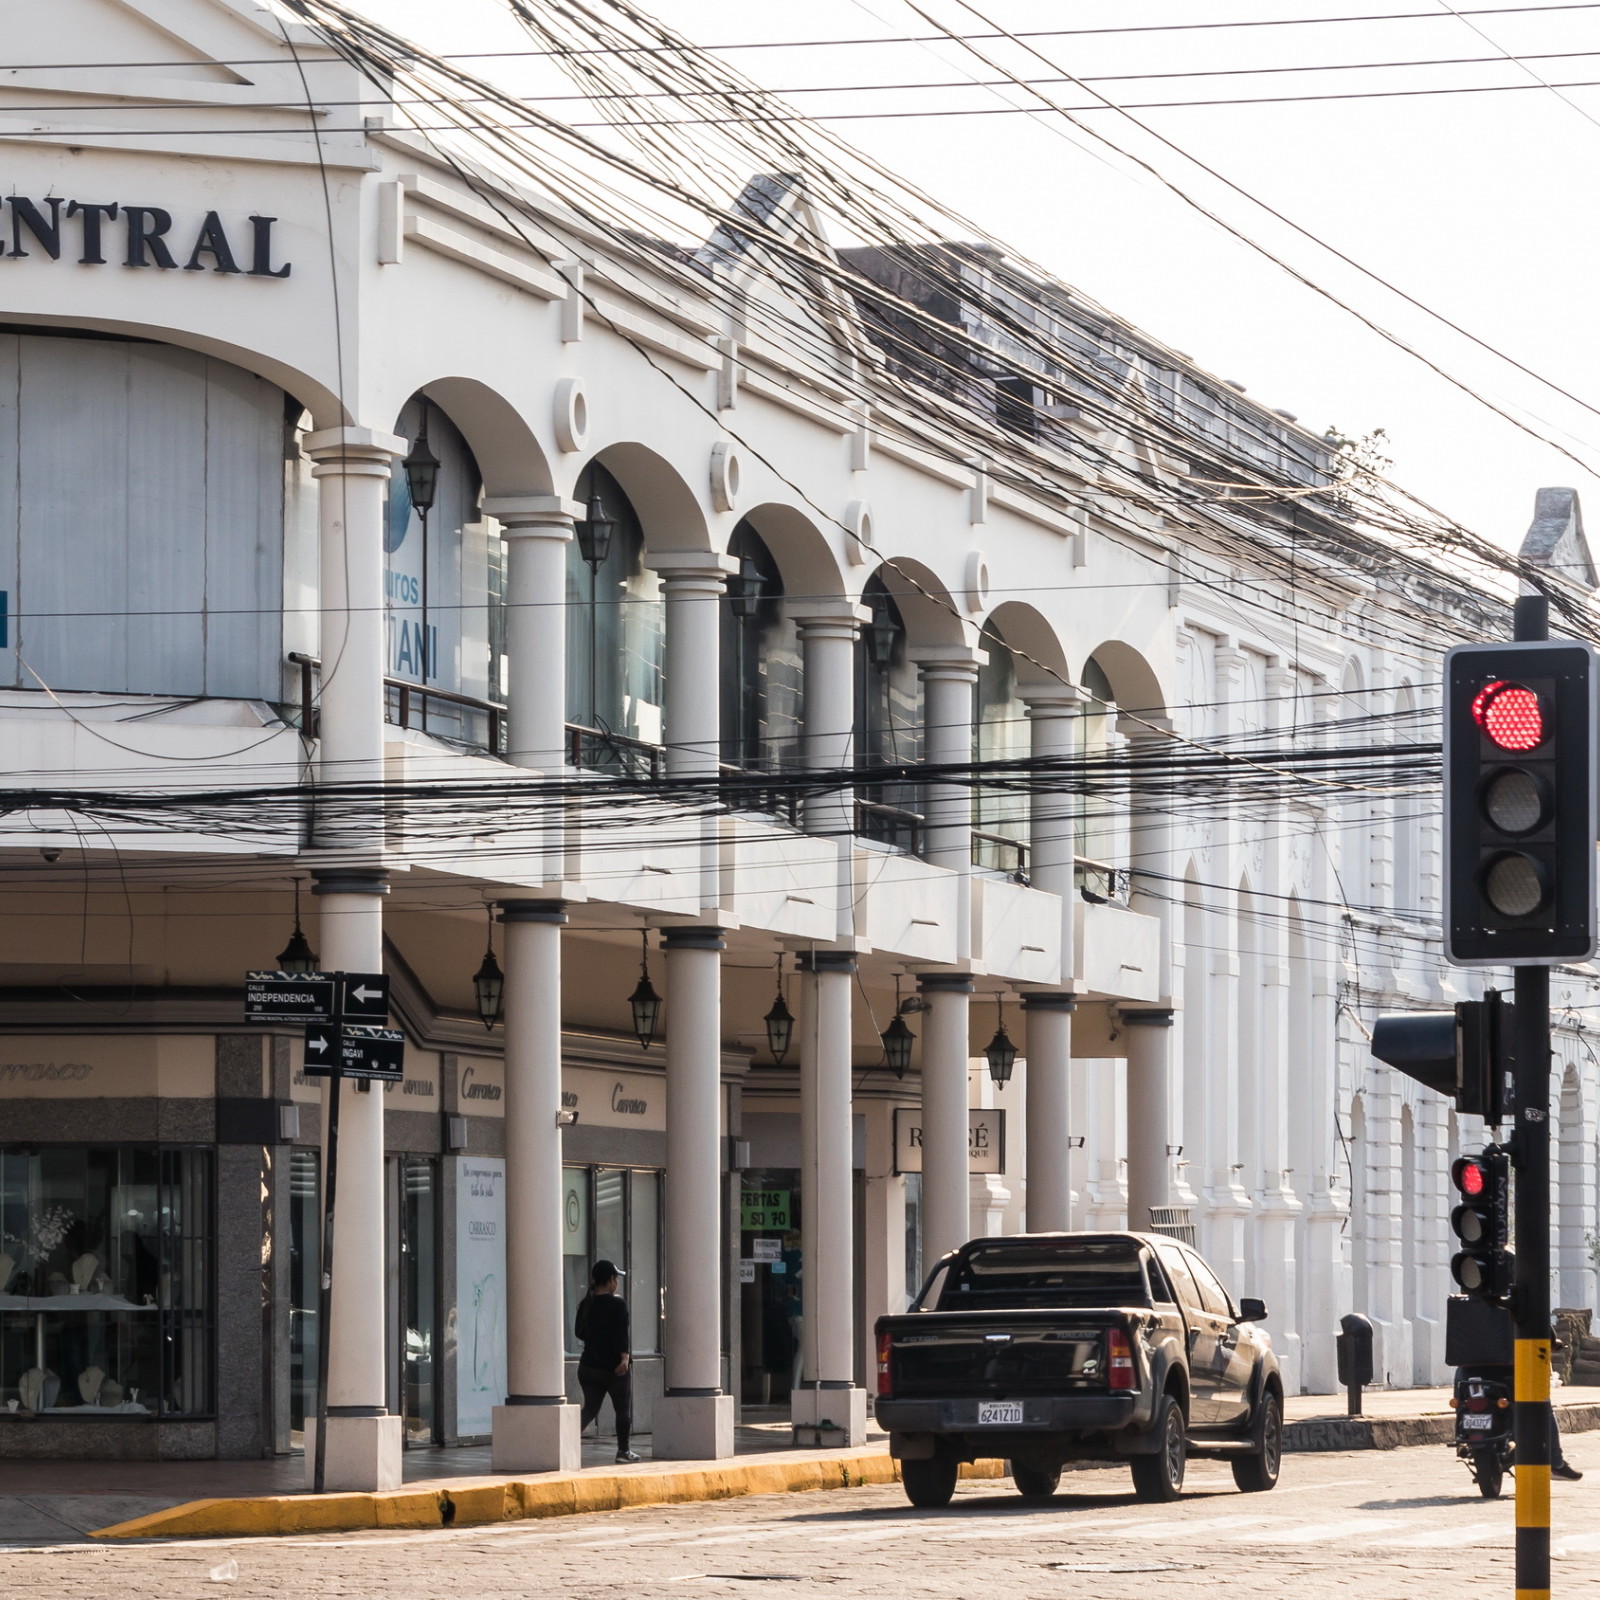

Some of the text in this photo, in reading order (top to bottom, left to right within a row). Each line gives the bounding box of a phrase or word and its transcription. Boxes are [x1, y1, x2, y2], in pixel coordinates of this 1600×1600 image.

[247, 992, 315, 1004] INDEPENDENCIA
[342, 1047, 363, 1058] INGAVI
[461, 1066, 502, 1101] Carrasco
